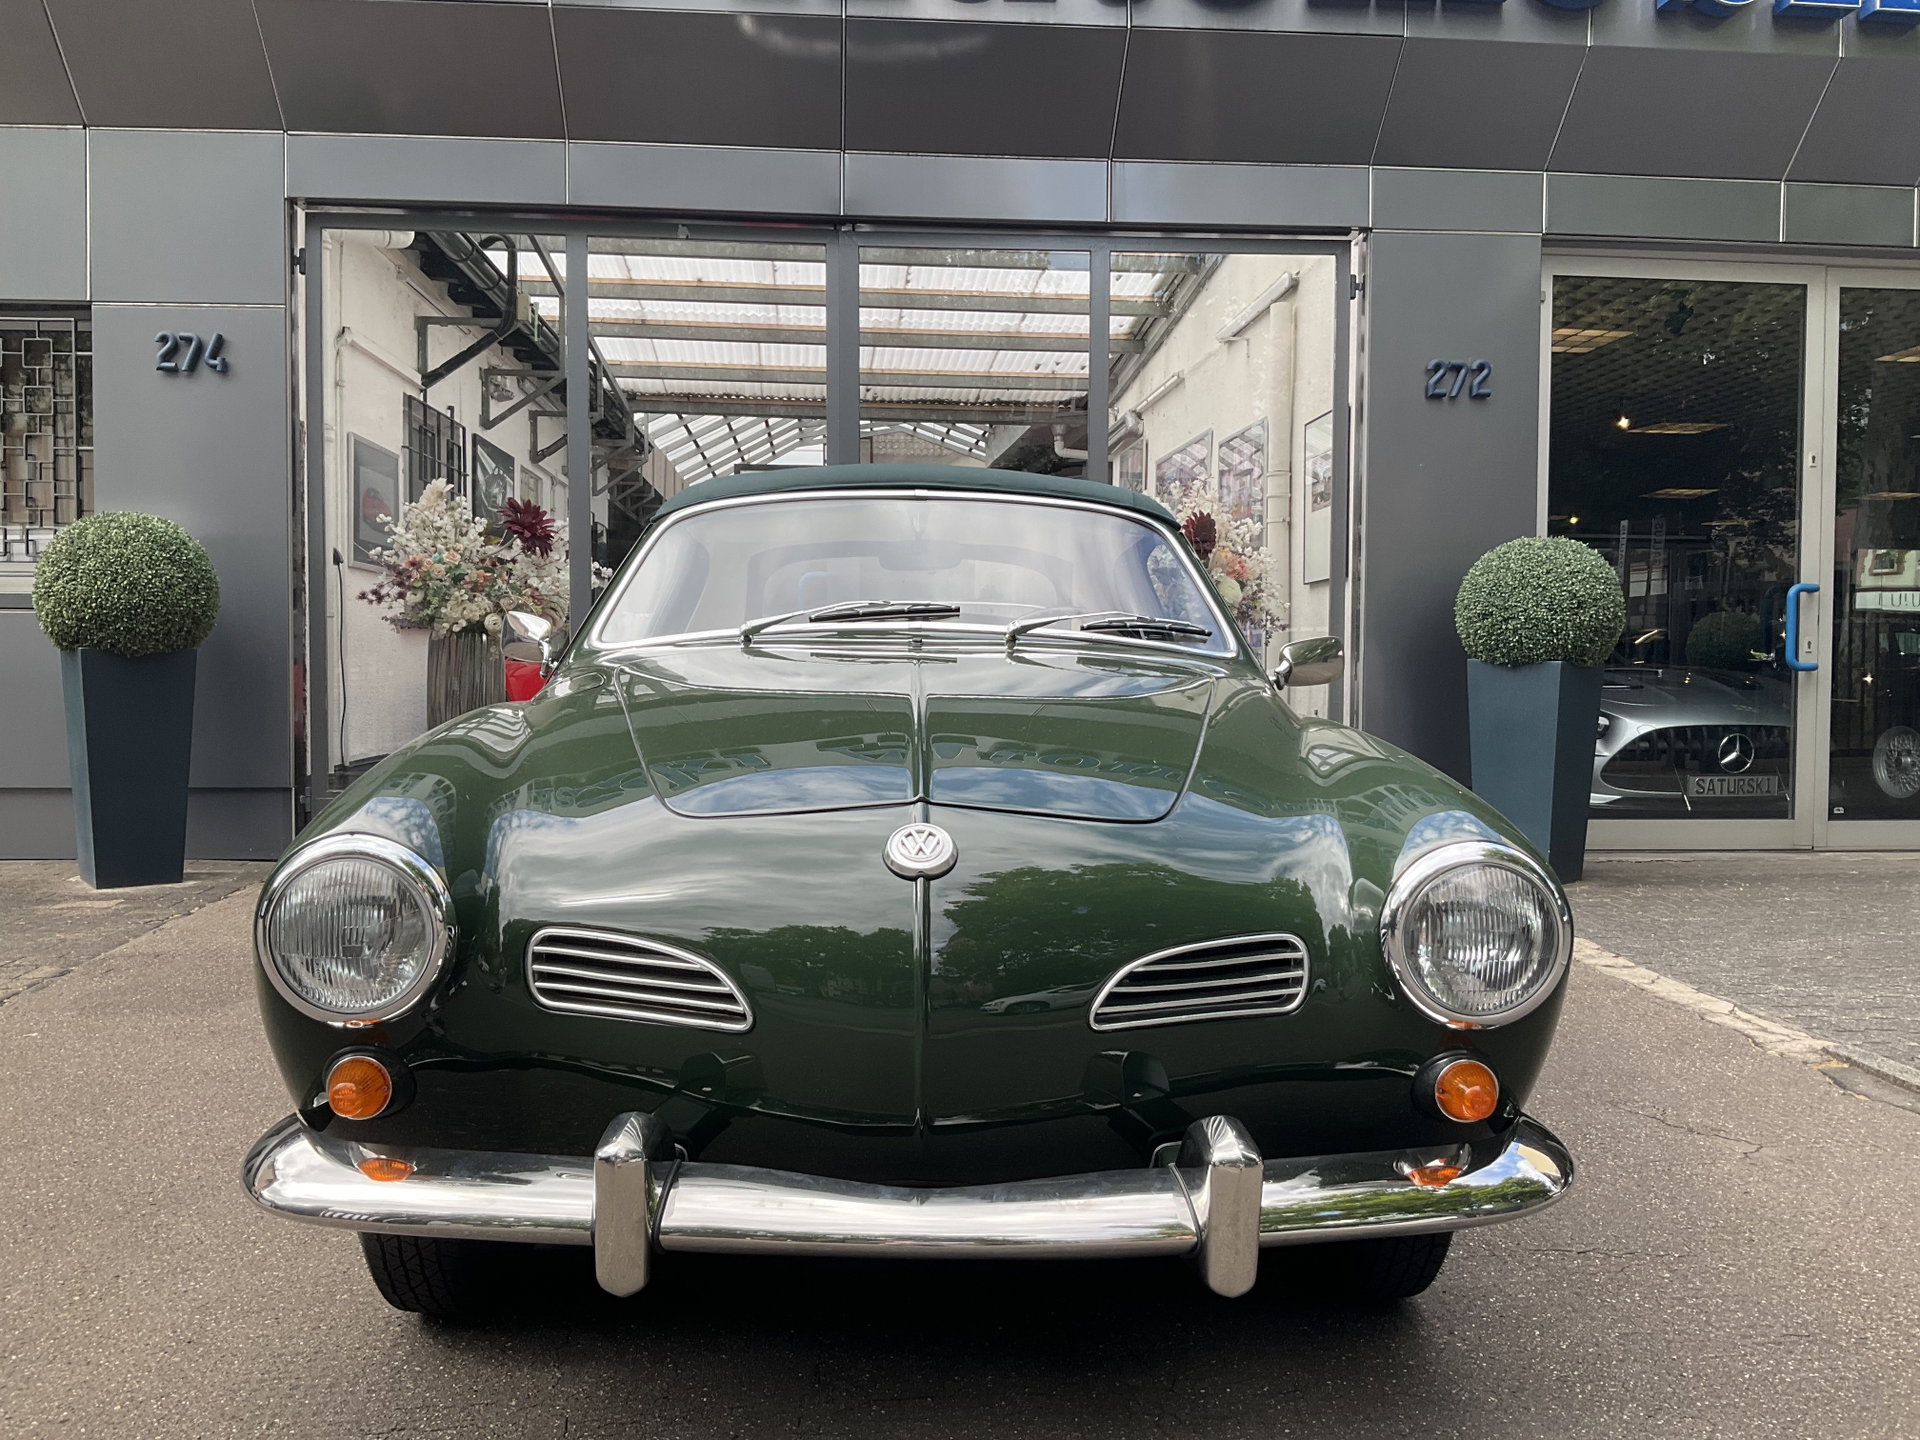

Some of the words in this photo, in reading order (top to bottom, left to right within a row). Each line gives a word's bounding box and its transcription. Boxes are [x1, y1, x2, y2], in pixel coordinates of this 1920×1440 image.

[154, 331, 229, 373] 274
[1425, 359, 1492, 400] 272
[1695, 777, 1772, 795] SATURSKI
